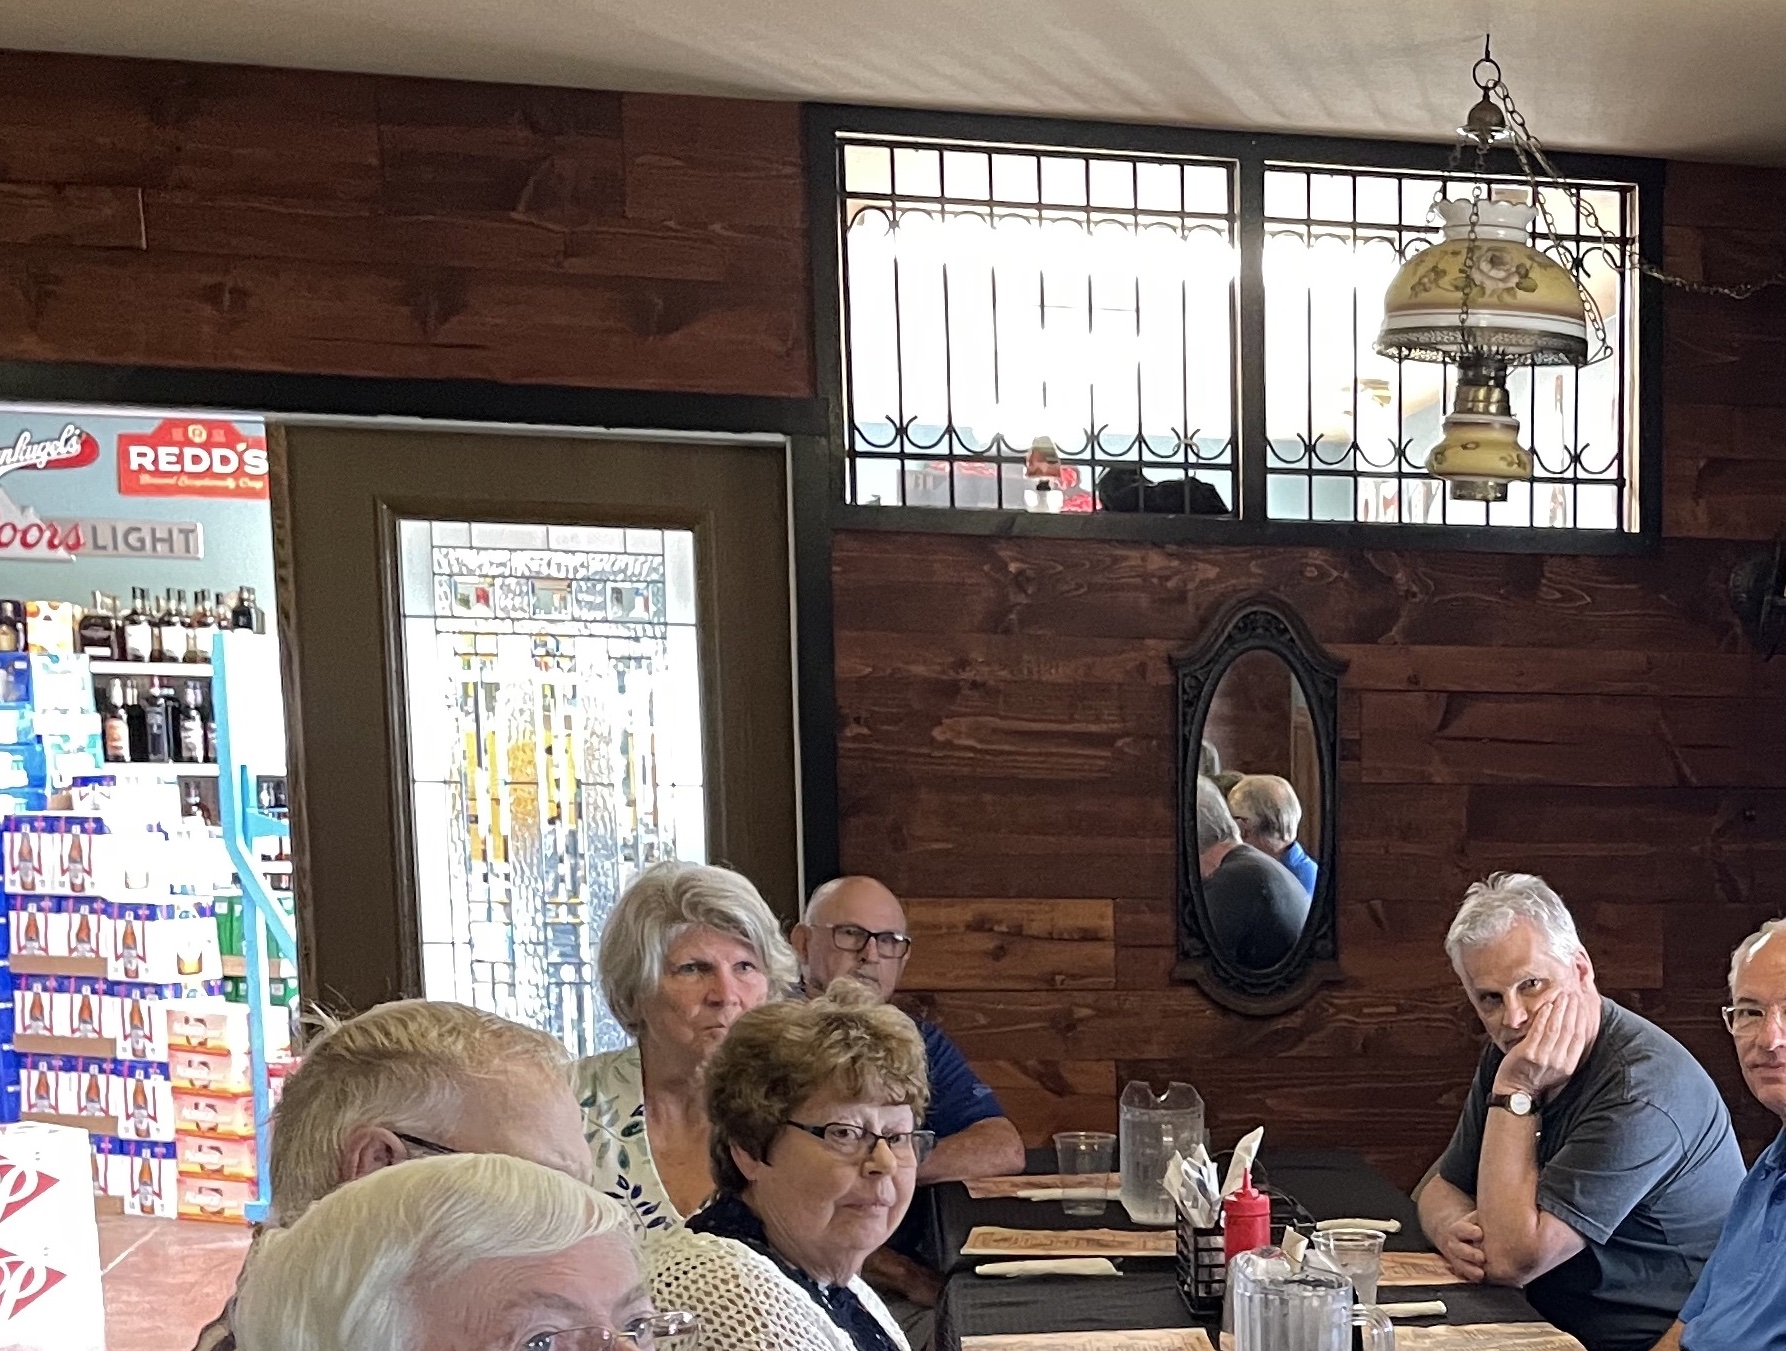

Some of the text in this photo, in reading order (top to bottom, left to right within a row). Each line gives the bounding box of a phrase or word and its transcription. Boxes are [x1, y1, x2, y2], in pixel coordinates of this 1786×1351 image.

[128, 442, 269, 475] REDD'S
[0, 522, 197, 554] oors LIGHT
